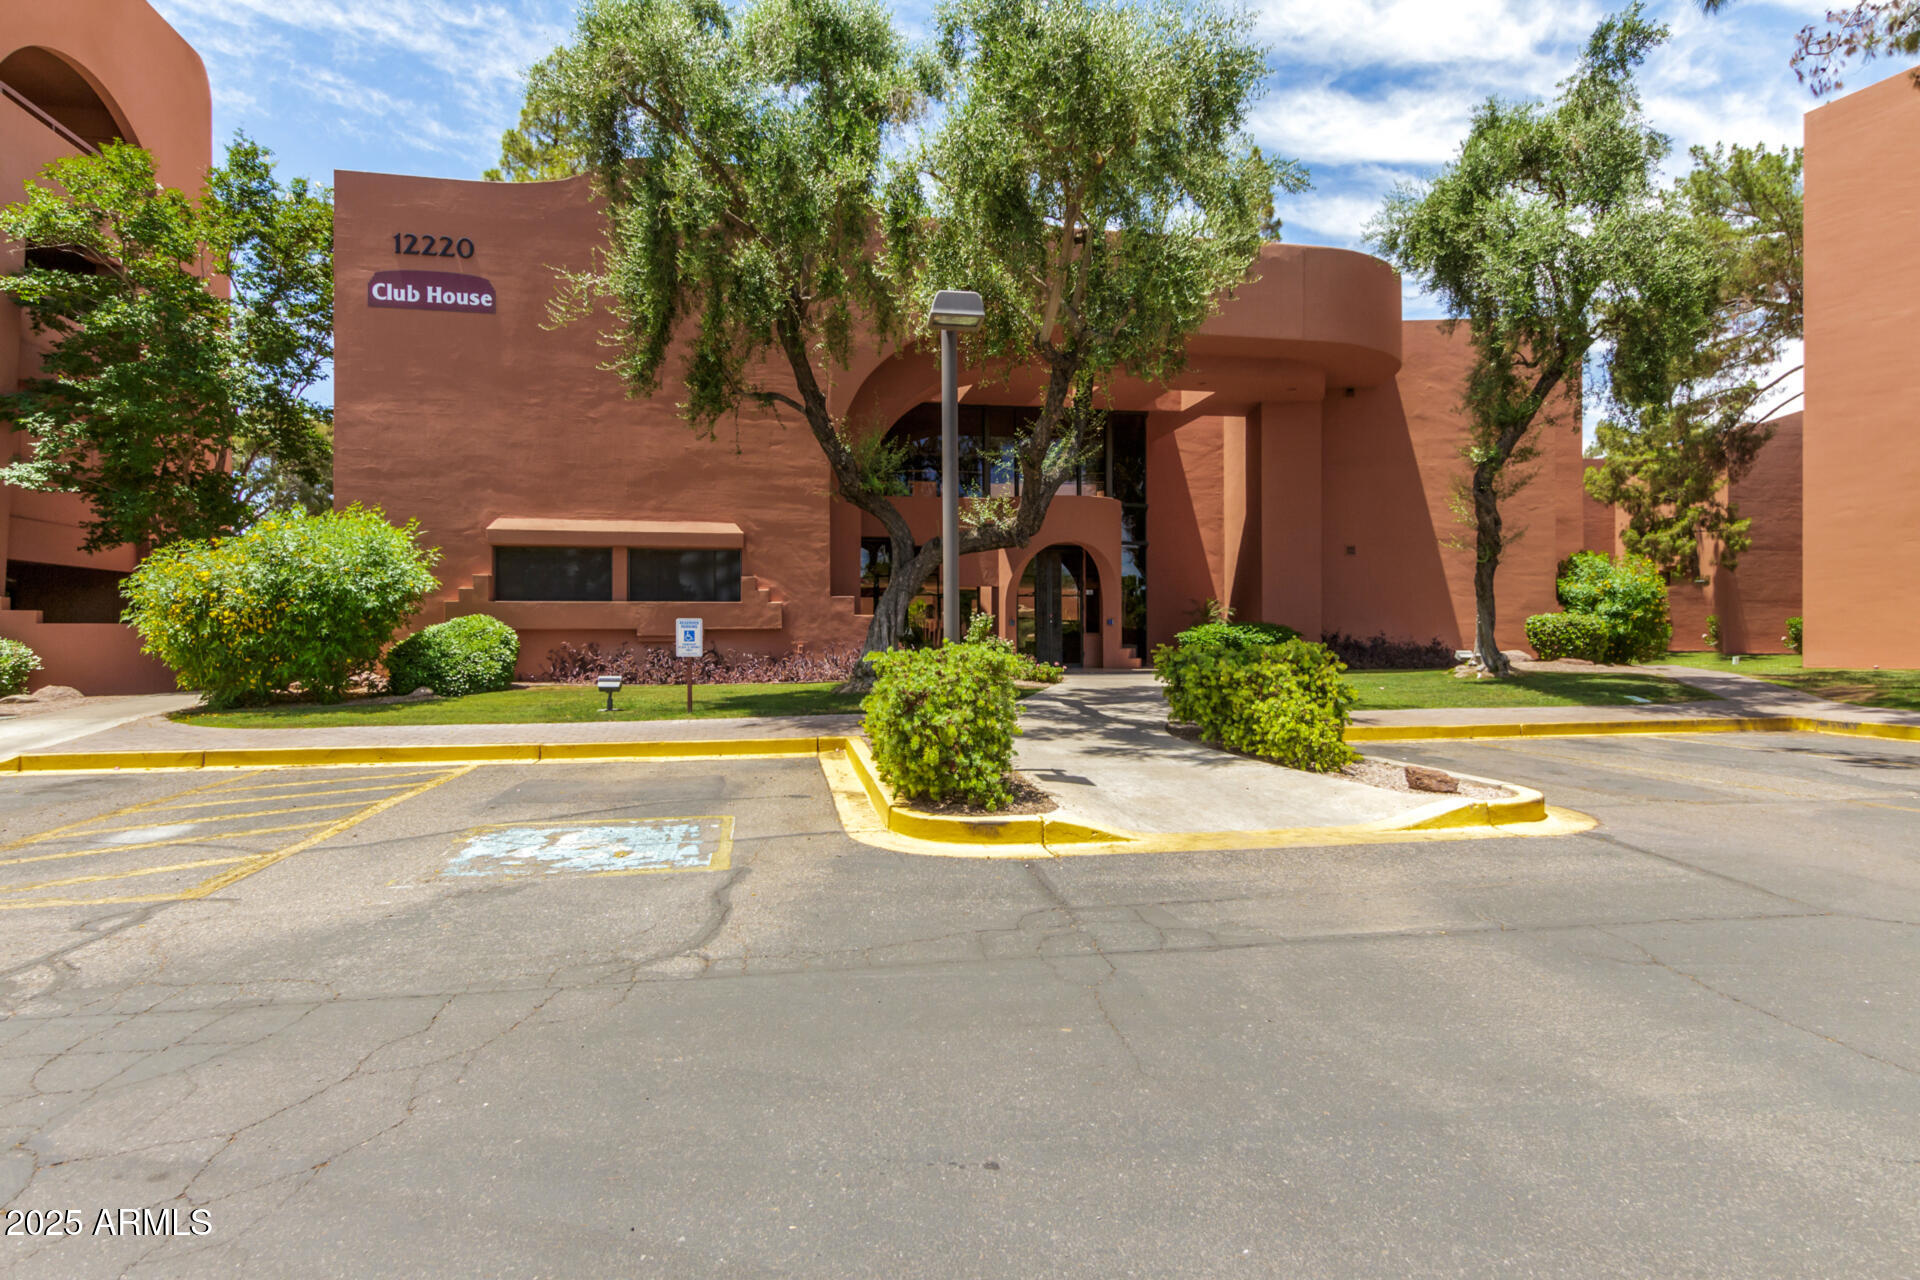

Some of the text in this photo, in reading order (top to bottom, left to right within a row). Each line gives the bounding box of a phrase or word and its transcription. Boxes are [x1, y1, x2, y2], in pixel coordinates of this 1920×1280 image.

[393, 233, 474, 259] 12220
[372, 282, 493, 307] Club House
